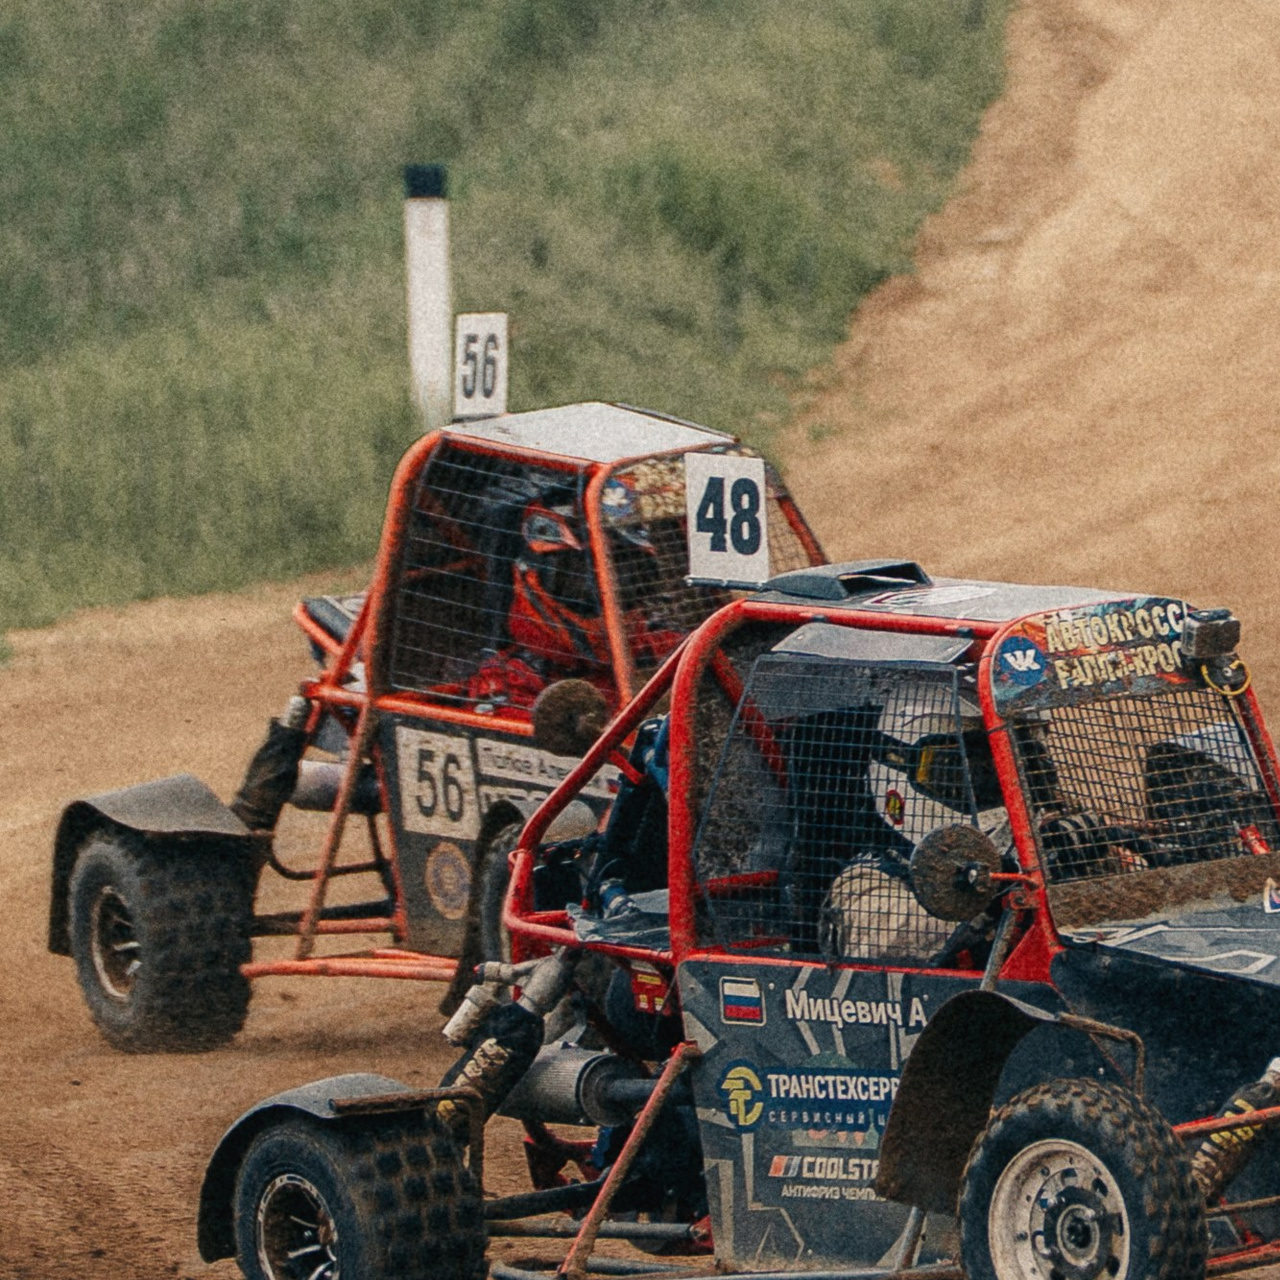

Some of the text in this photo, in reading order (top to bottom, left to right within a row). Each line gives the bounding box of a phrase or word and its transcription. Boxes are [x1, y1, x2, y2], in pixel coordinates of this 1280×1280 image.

[462, 332, 500, 400] 56
[696, 475, 761, 556] 48
[416, 748, 464, 823] 56
[785, 989, 928, 1029] Мицевич А
[768, 1110, 865, 1125] СЕРВИСНЫЙ
[781, 1184, 841, 1200] АНТИФРИЗ
